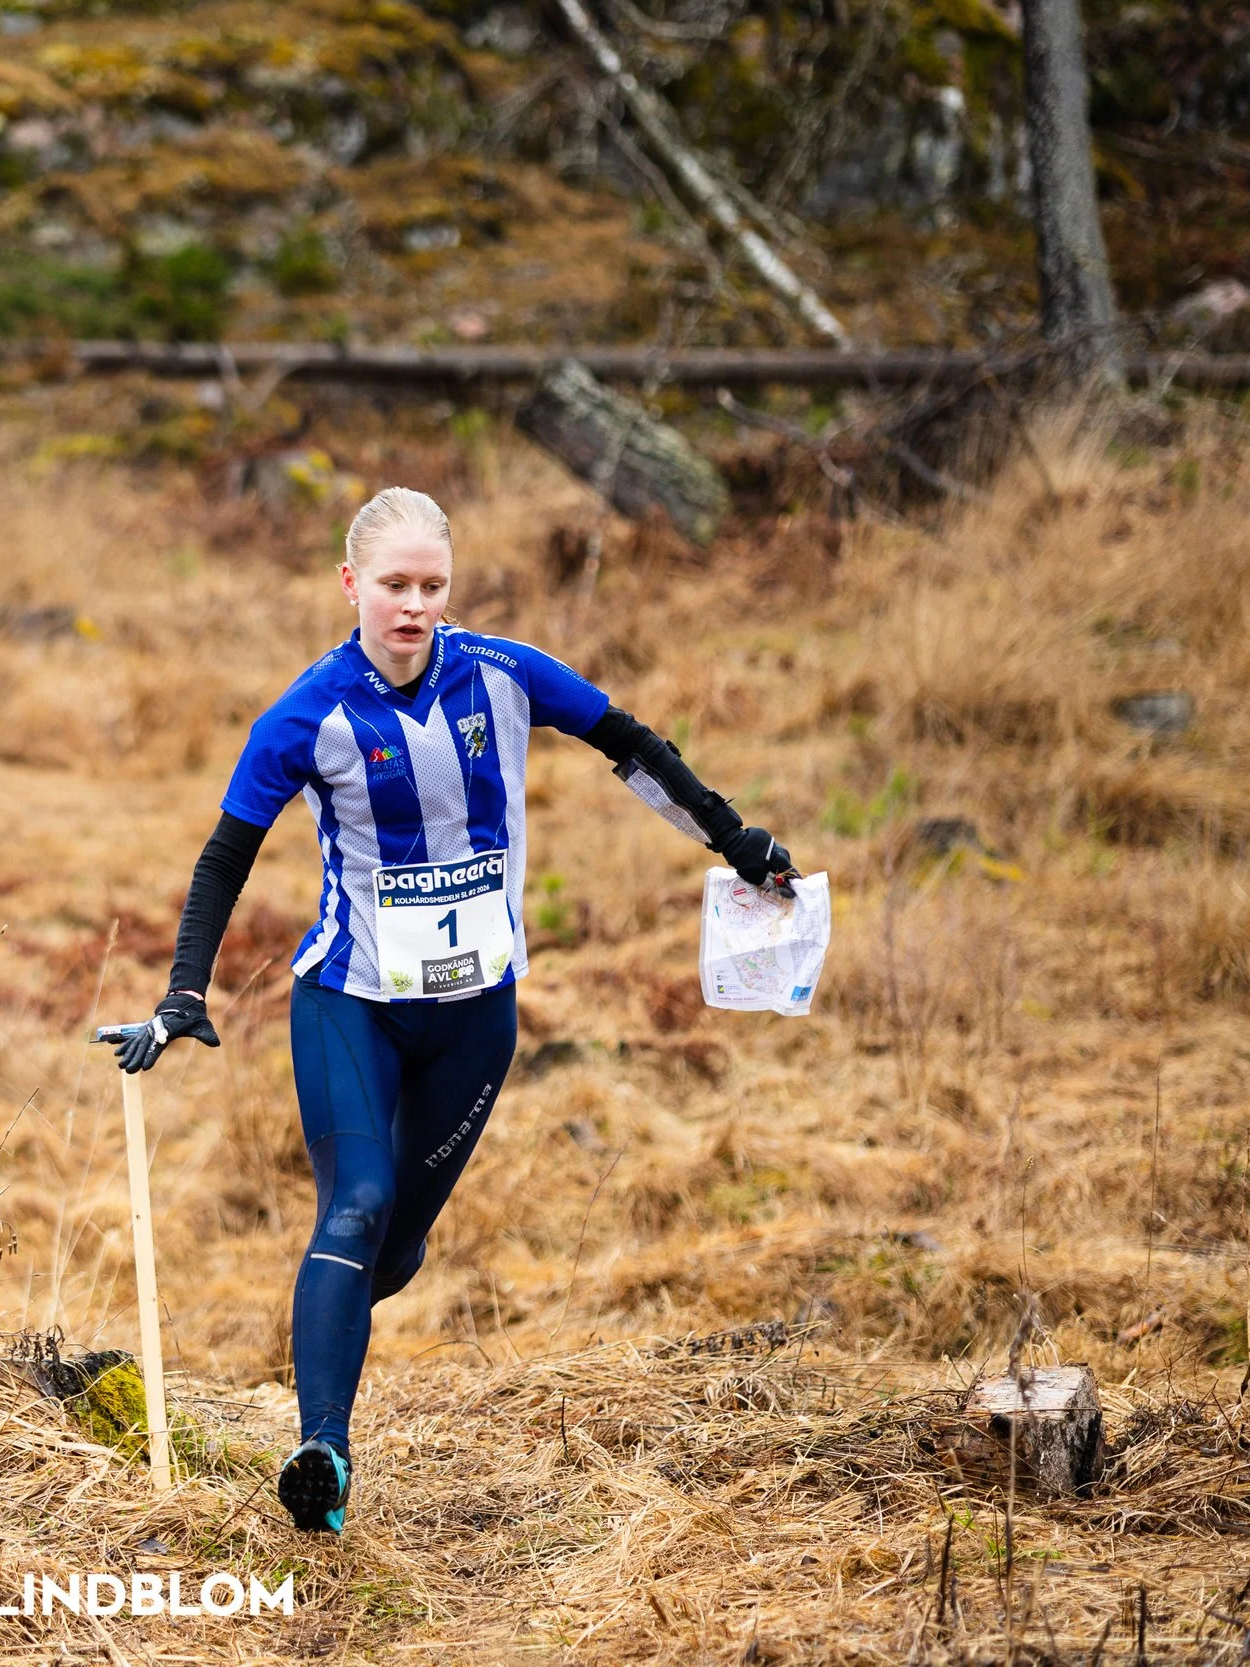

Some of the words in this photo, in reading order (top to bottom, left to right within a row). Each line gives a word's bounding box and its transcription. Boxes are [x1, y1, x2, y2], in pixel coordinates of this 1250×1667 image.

[428, 636, 445, 688] noname
[459, 642, 518, 668] noname
[394, 893, 460, 905] KOLMÅRDSMEDELN
[461, 891, 468, 899] SL
[468, 888, 477, 897] #2
[476, 884, 490, 894] 2026
[437, 908, 458, 948] 1
[427, 957, 474, 972] GODKÄNDA
[428, 964, 475, 983] AVLOPP
